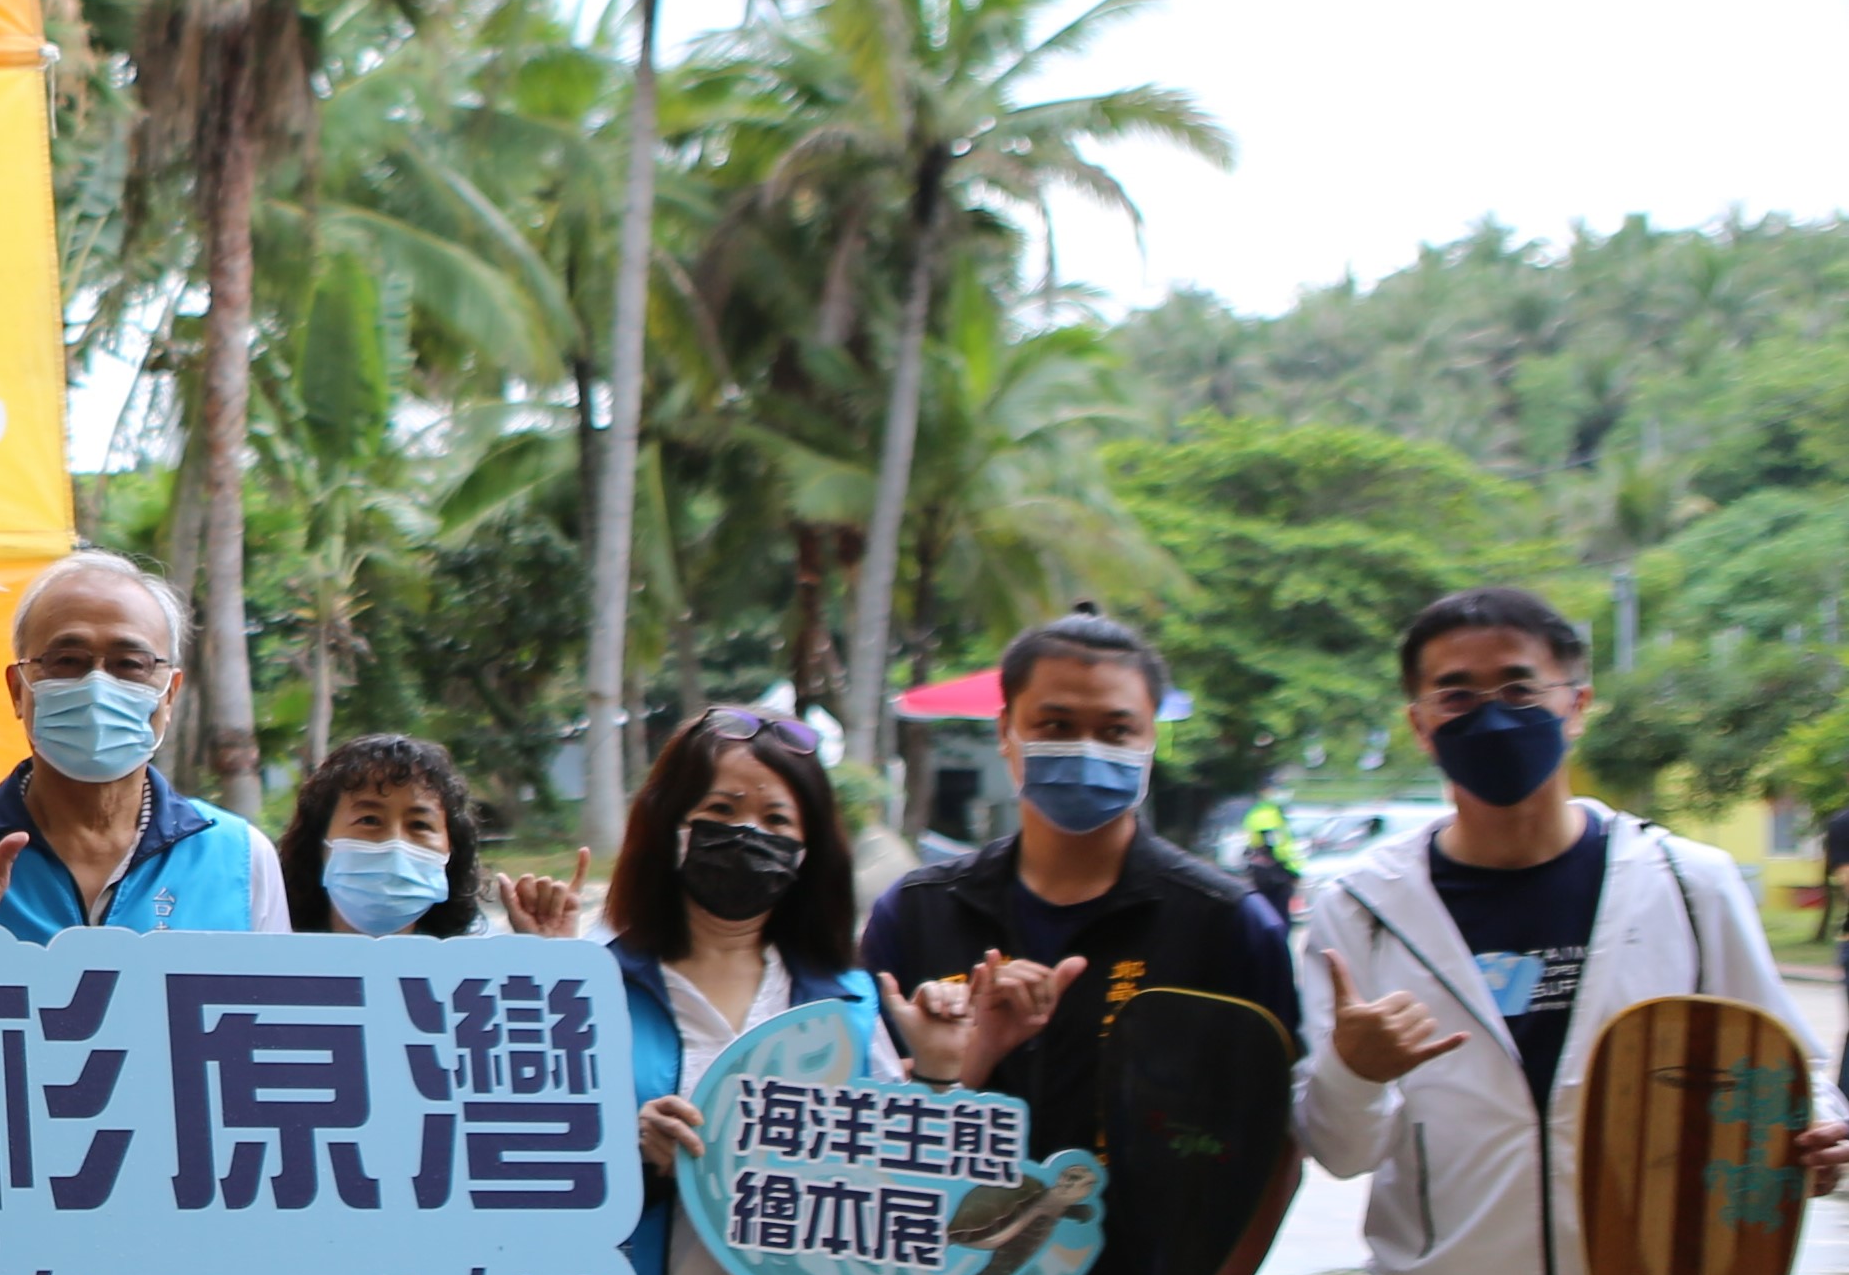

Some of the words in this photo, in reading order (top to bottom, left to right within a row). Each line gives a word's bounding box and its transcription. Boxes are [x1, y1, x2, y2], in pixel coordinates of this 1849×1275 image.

[153, 886, 176, 931] 台
[736, 1077, 1018, 1186] 海洋生態
[730, 1169, 942, 1268] 繪本展
